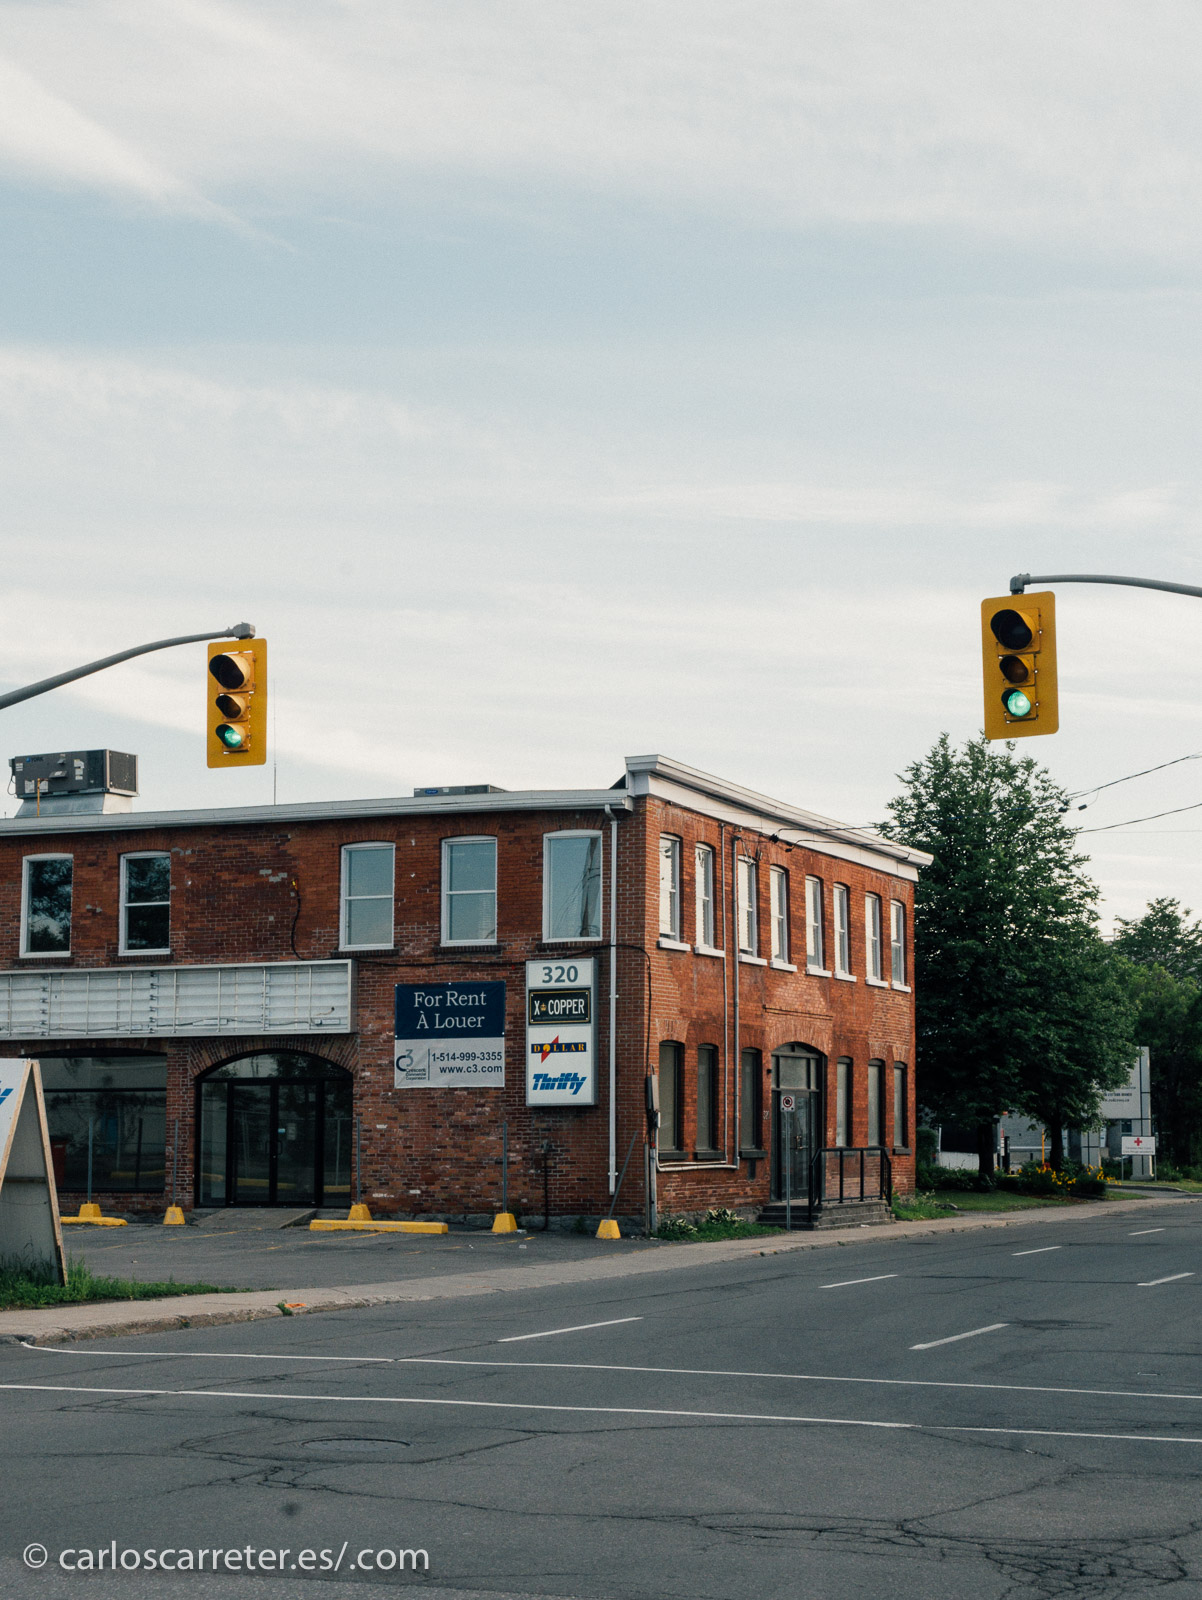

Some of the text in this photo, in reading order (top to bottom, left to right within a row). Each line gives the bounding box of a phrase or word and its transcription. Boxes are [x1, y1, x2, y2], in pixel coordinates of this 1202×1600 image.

[542, 965, 579, 983] 320
[413, 990, 487, 1008] For Rent
[533, 998, 585, 1016] X COPPER
[416, 1010, 485, 1029] À Louer
[431, 1051, 503, 1062] 1-514-999-3355
[533, 1043, 585, 1053] DOLLAR
[439, 1063, 503, 1074] www.c3.com
[532, 1072, 587, 1095] Thrifty
